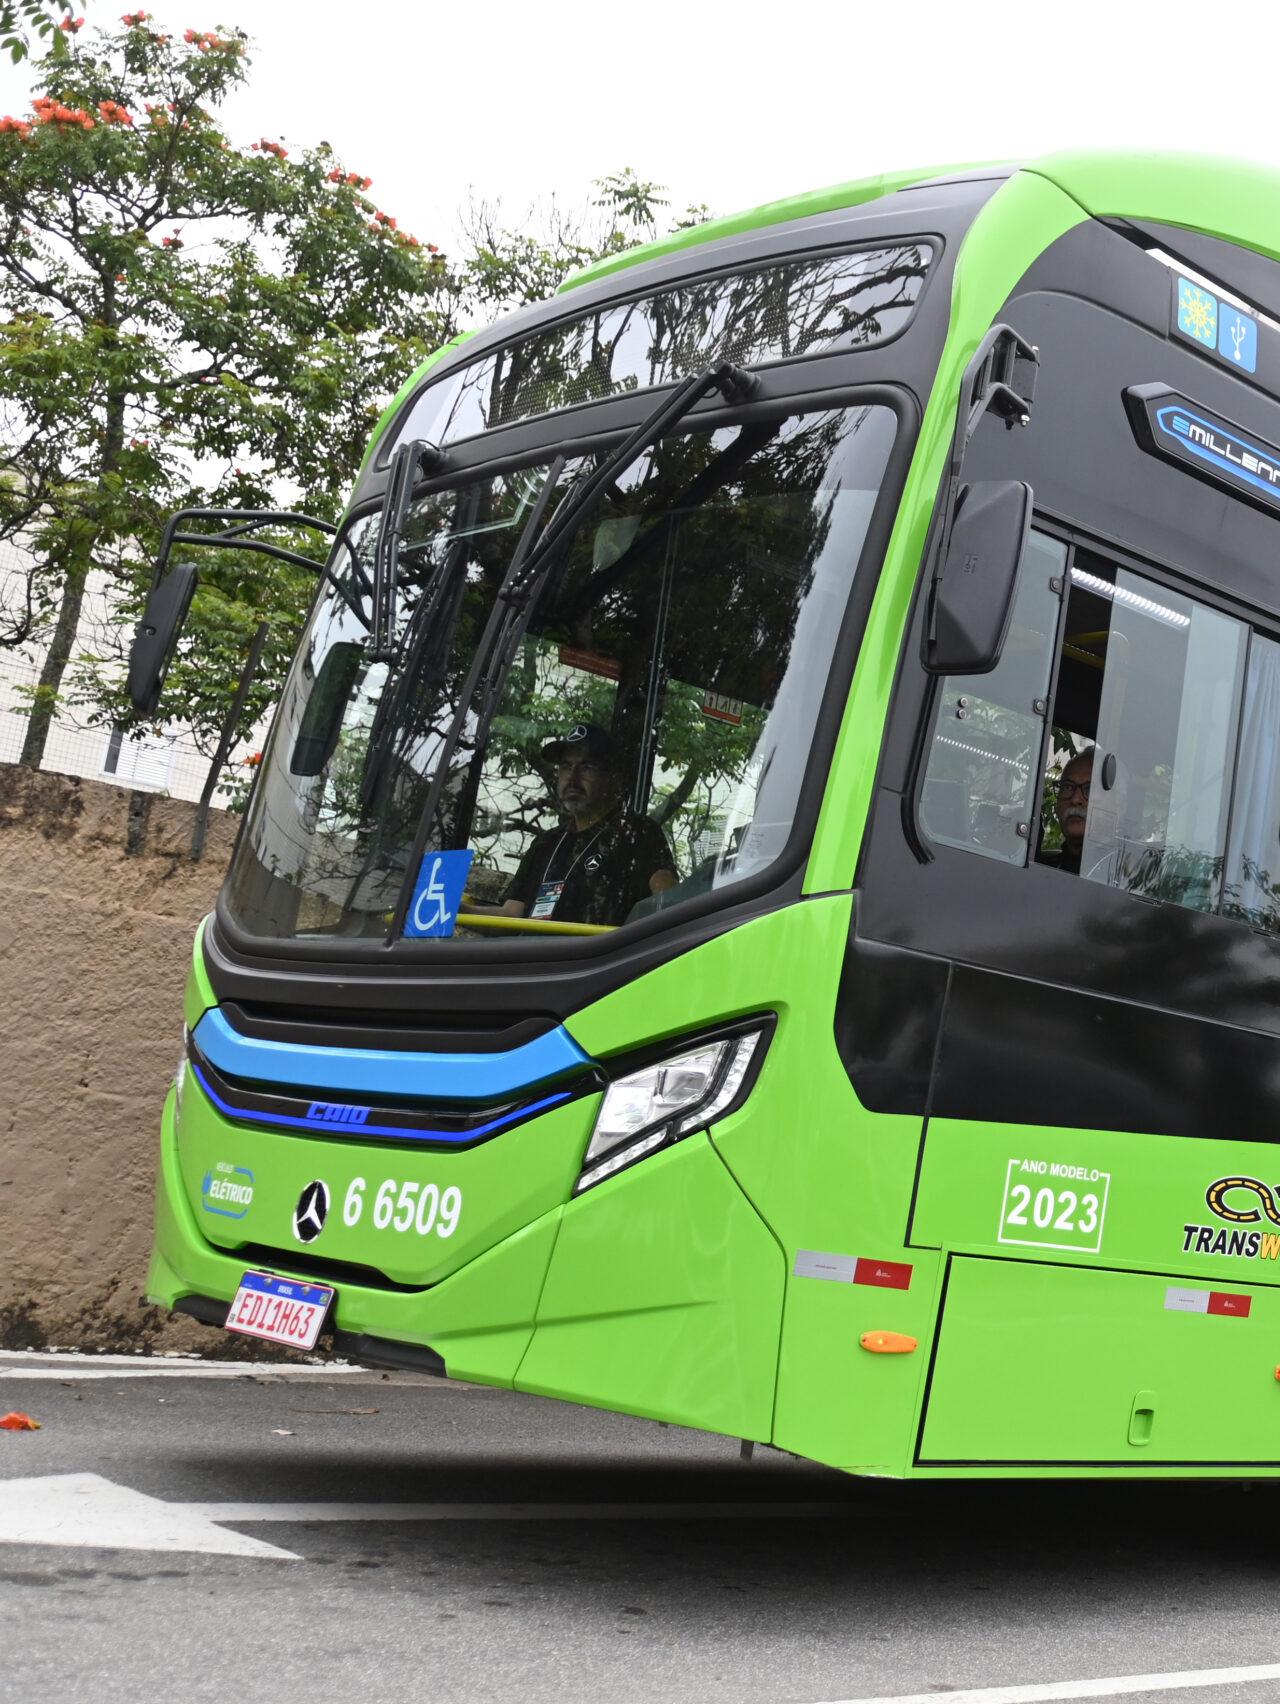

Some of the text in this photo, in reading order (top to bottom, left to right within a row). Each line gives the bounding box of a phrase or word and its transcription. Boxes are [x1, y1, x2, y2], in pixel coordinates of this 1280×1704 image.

[306, 1102, 371, 1125] CAIO
[1020, 1159, 1099, 1182] ANO MODELO
[209, 1178, 254, 1205] ELÉTRICO
[343, 1177, 462, 1238] 6 6509
[1006, 1184, 1098, 1233] 2023
